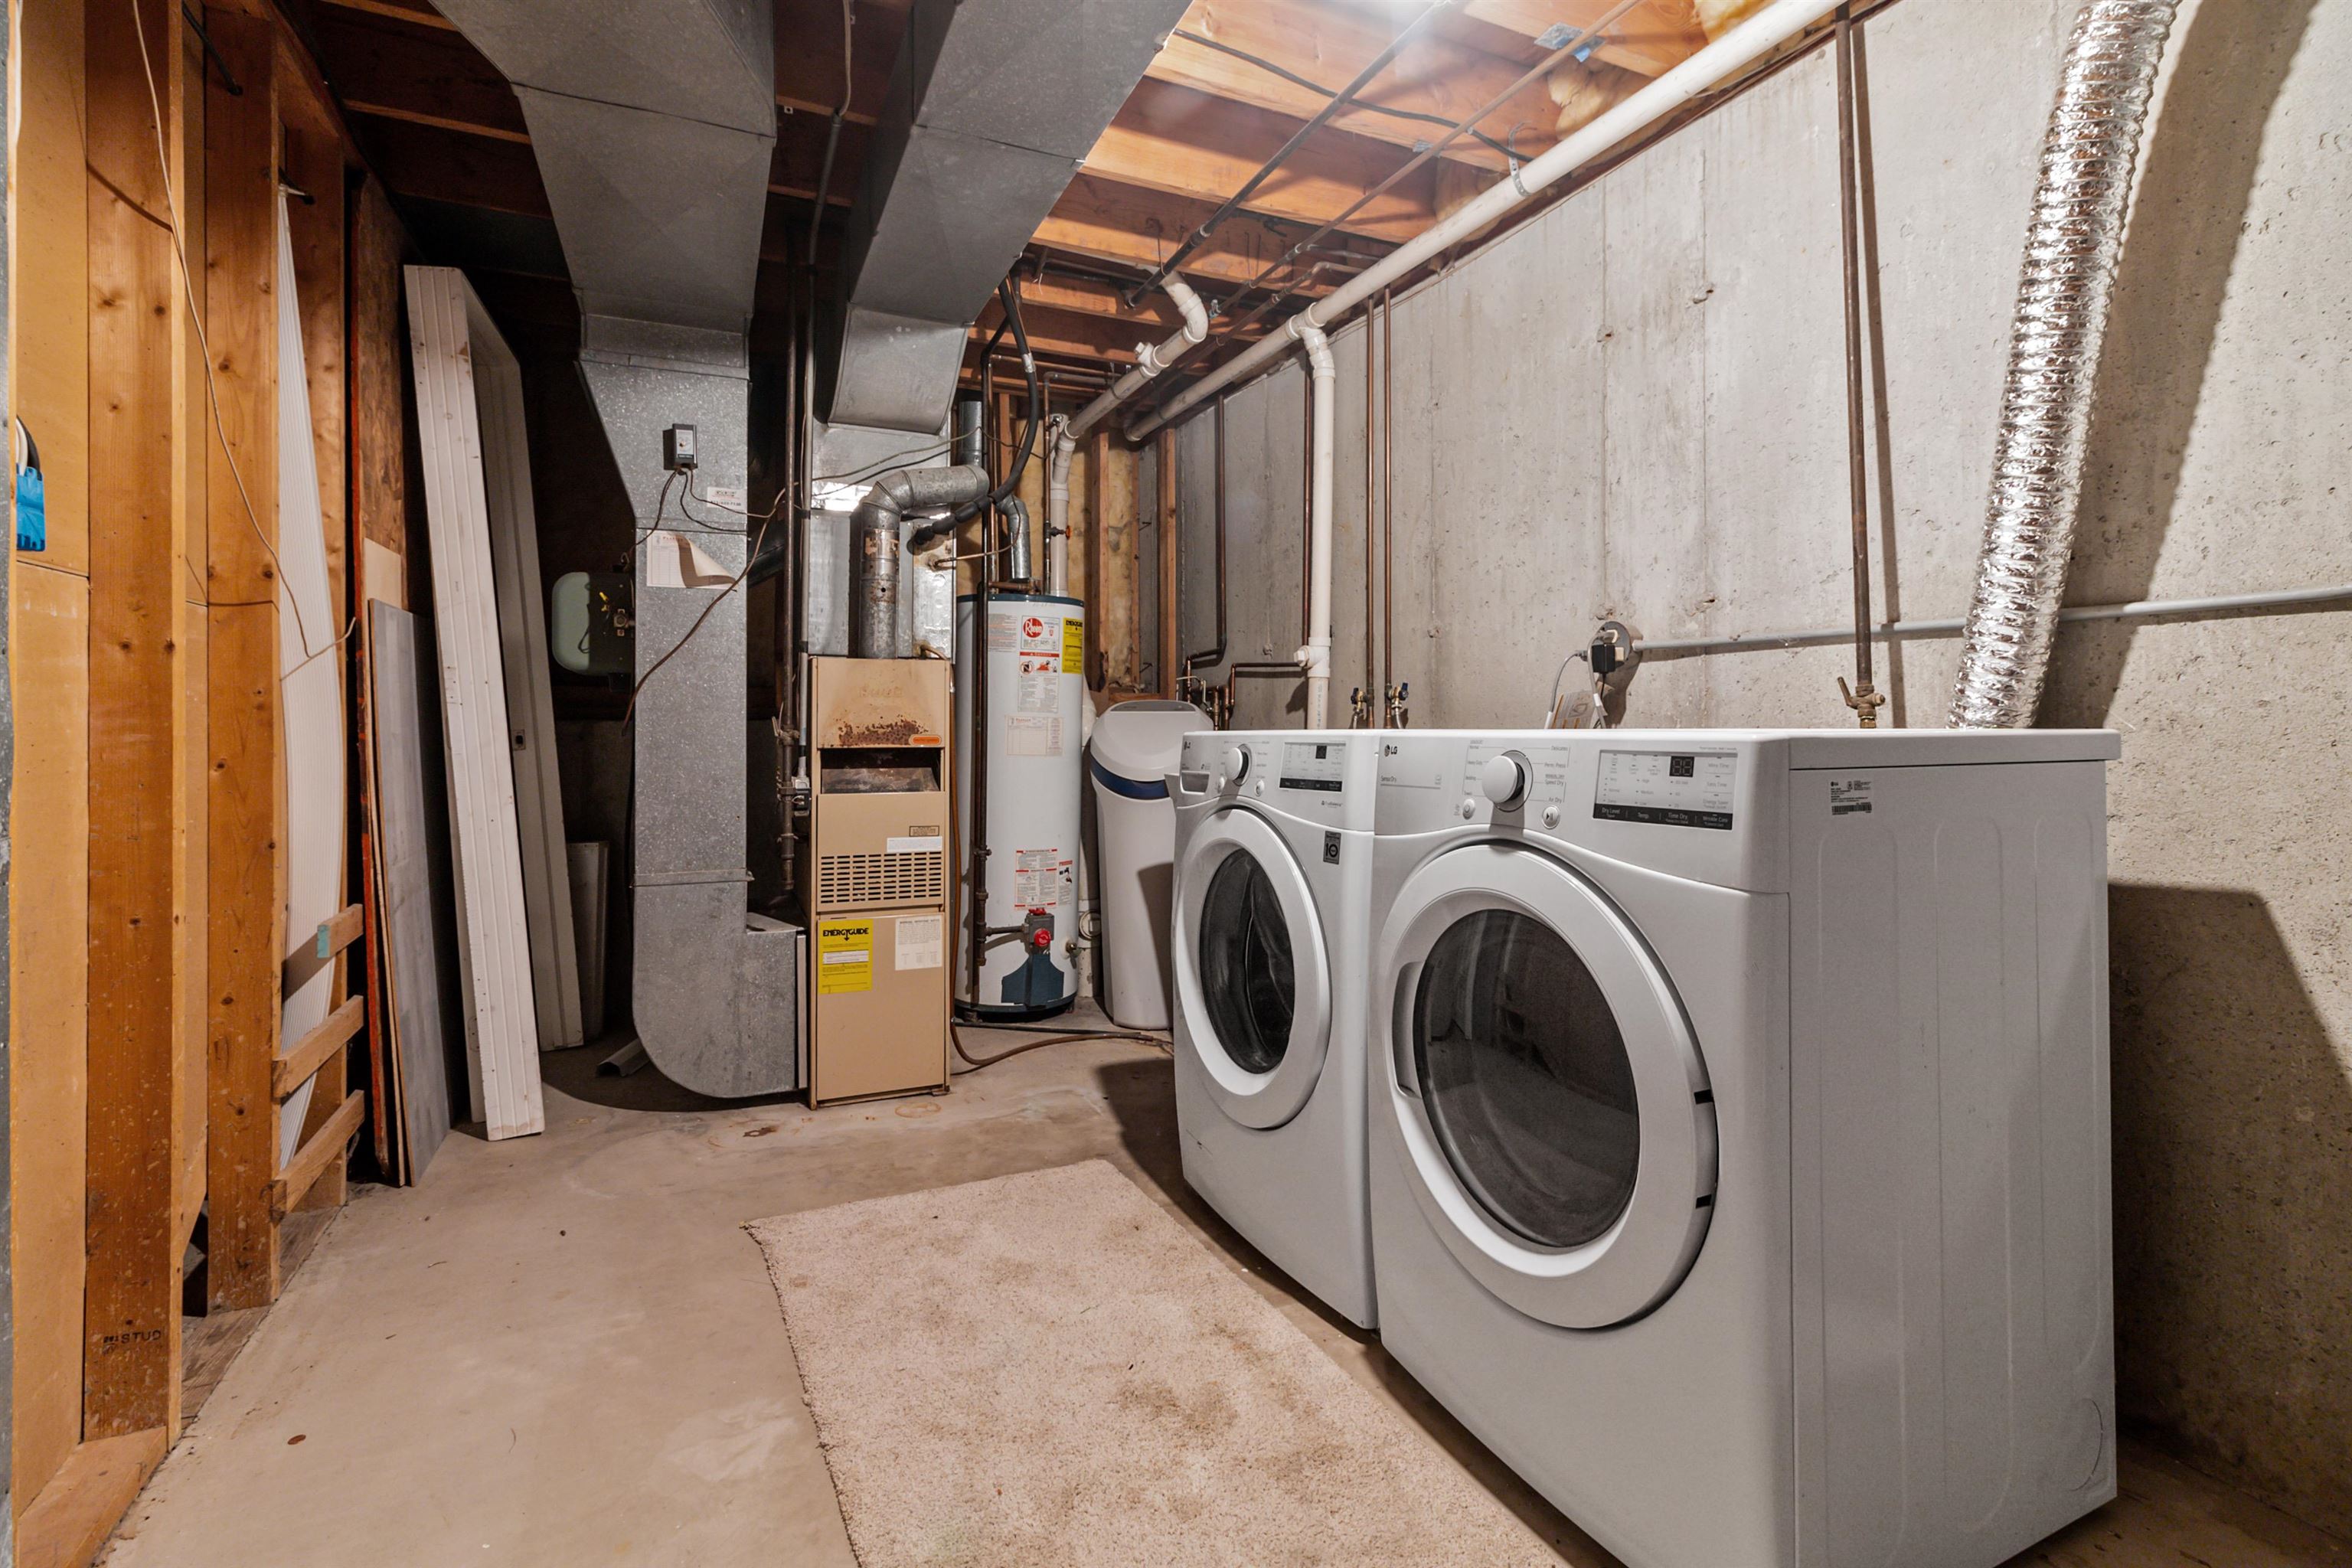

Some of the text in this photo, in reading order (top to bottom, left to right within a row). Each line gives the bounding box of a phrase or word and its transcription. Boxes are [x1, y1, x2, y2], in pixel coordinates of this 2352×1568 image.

[1024, 618, 1044, 636] Rheem
[1390, 746, 1398, 755] LG
[822, 927, 869, 937] ENERGYGUIDE
[121, 1330, 161, 1344] STUD
